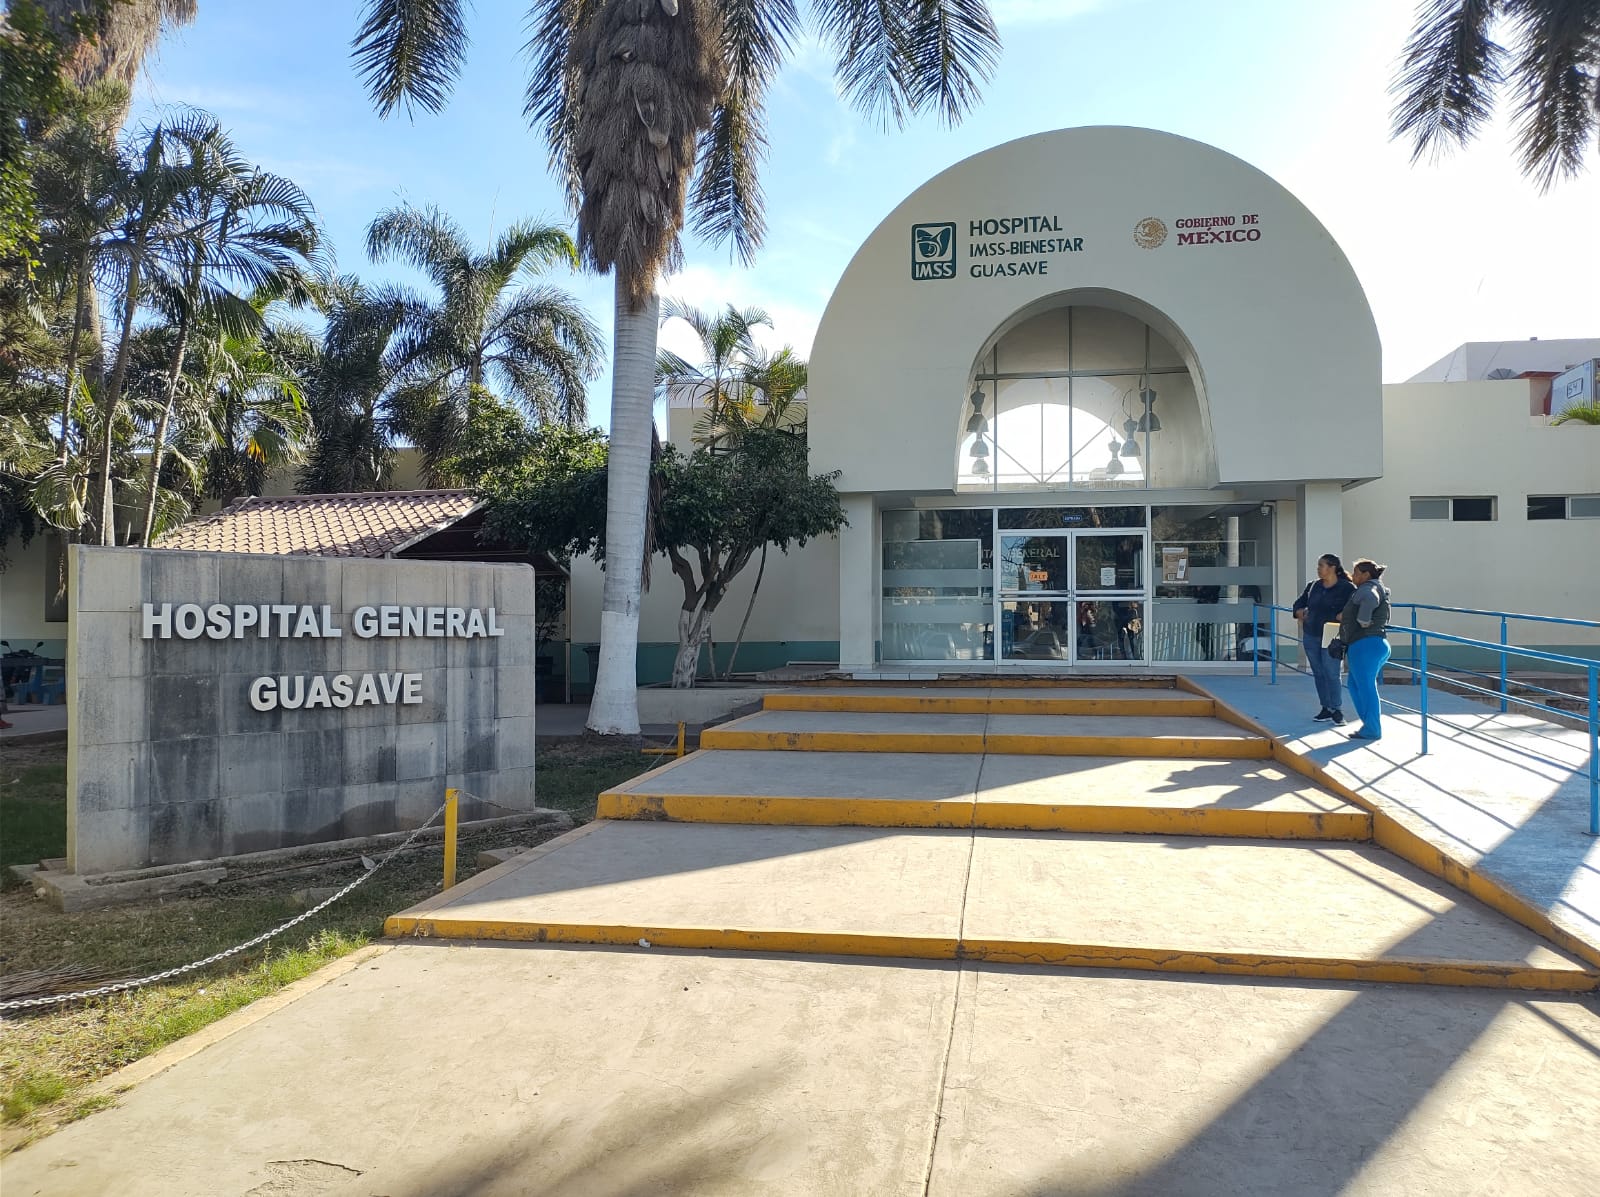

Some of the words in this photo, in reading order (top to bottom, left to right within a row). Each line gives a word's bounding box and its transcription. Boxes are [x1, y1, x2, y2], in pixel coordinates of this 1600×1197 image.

[969, 216, 1063, 237] HOSPITAL
[1175, 216, 1236, 229] GOBIERNO
[1242, 214, 1259, 225] DE
[1177, 227, 1262, 246] MÉXICO
[969, 238, 1084, 258] IMSS-BIENESTAR
[915, 262, 953, 278] IMSS
[969, 261, 1049, 279] GUASAVE
[142, 602, 342, 640] HOSPITAL
[353, 606, 505, 639] GENERAL
[250, 672, 424, 712] GUASAVE
